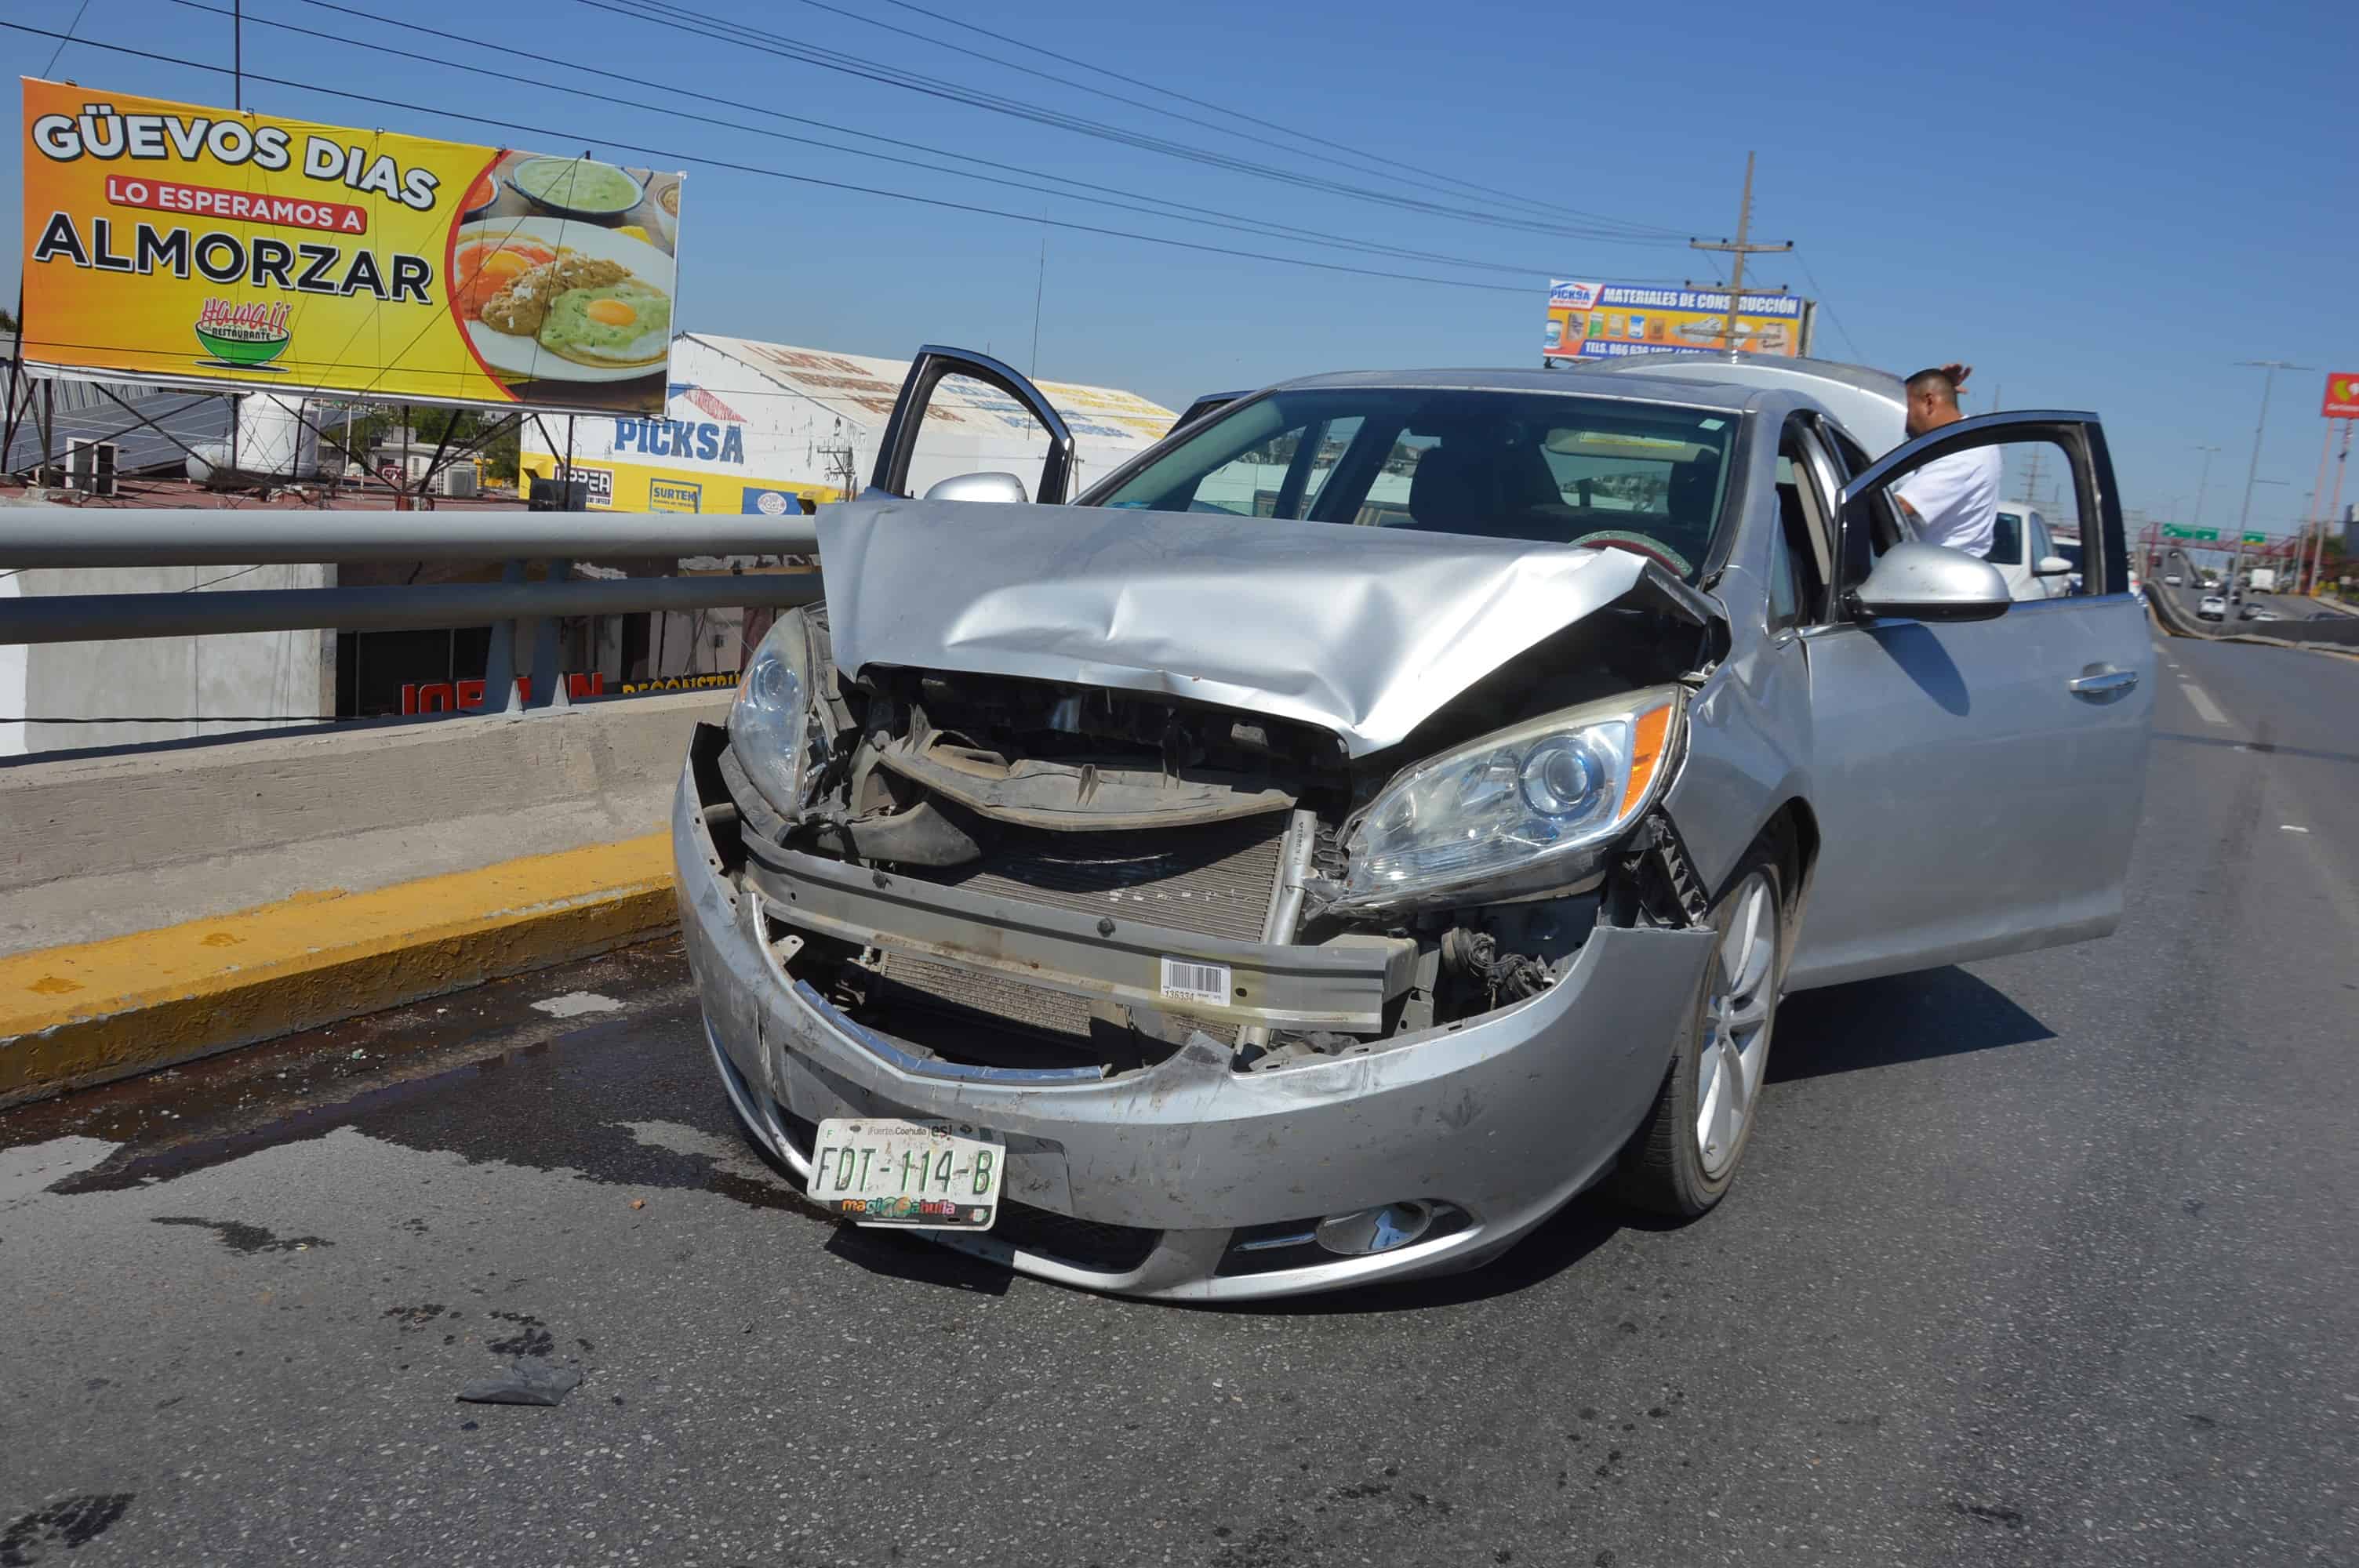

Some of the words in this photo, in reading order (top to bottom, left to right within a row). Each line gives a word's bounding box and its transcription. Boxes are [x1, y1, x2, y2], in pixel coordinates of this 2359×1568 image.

[32, 103, 291, 170] GÜEVOS
[304, 136, 442, 212] DIAS
[108, 180, 149, 205] LO
[158, 185, 334, 230] ESPERAMOS
[340, 208, 362, 231] A
[32, 212, 434, 306] ALMORZAR
[1550, 289, 1590, 301] PICKSA
[1603, 288, 1677, 306] MATERIALES
[1681, 292, 1695, 307] DE
[1697, 294, 1797, 314] CONSRUCCIÓN
[212, 327, 271, 340] RESTAURANTE
[615, 417, 744, 466] PICKSA
[653, 487, 698, 501] SURTEK
[816, 1147, 994, 1195] FDT-114-B
